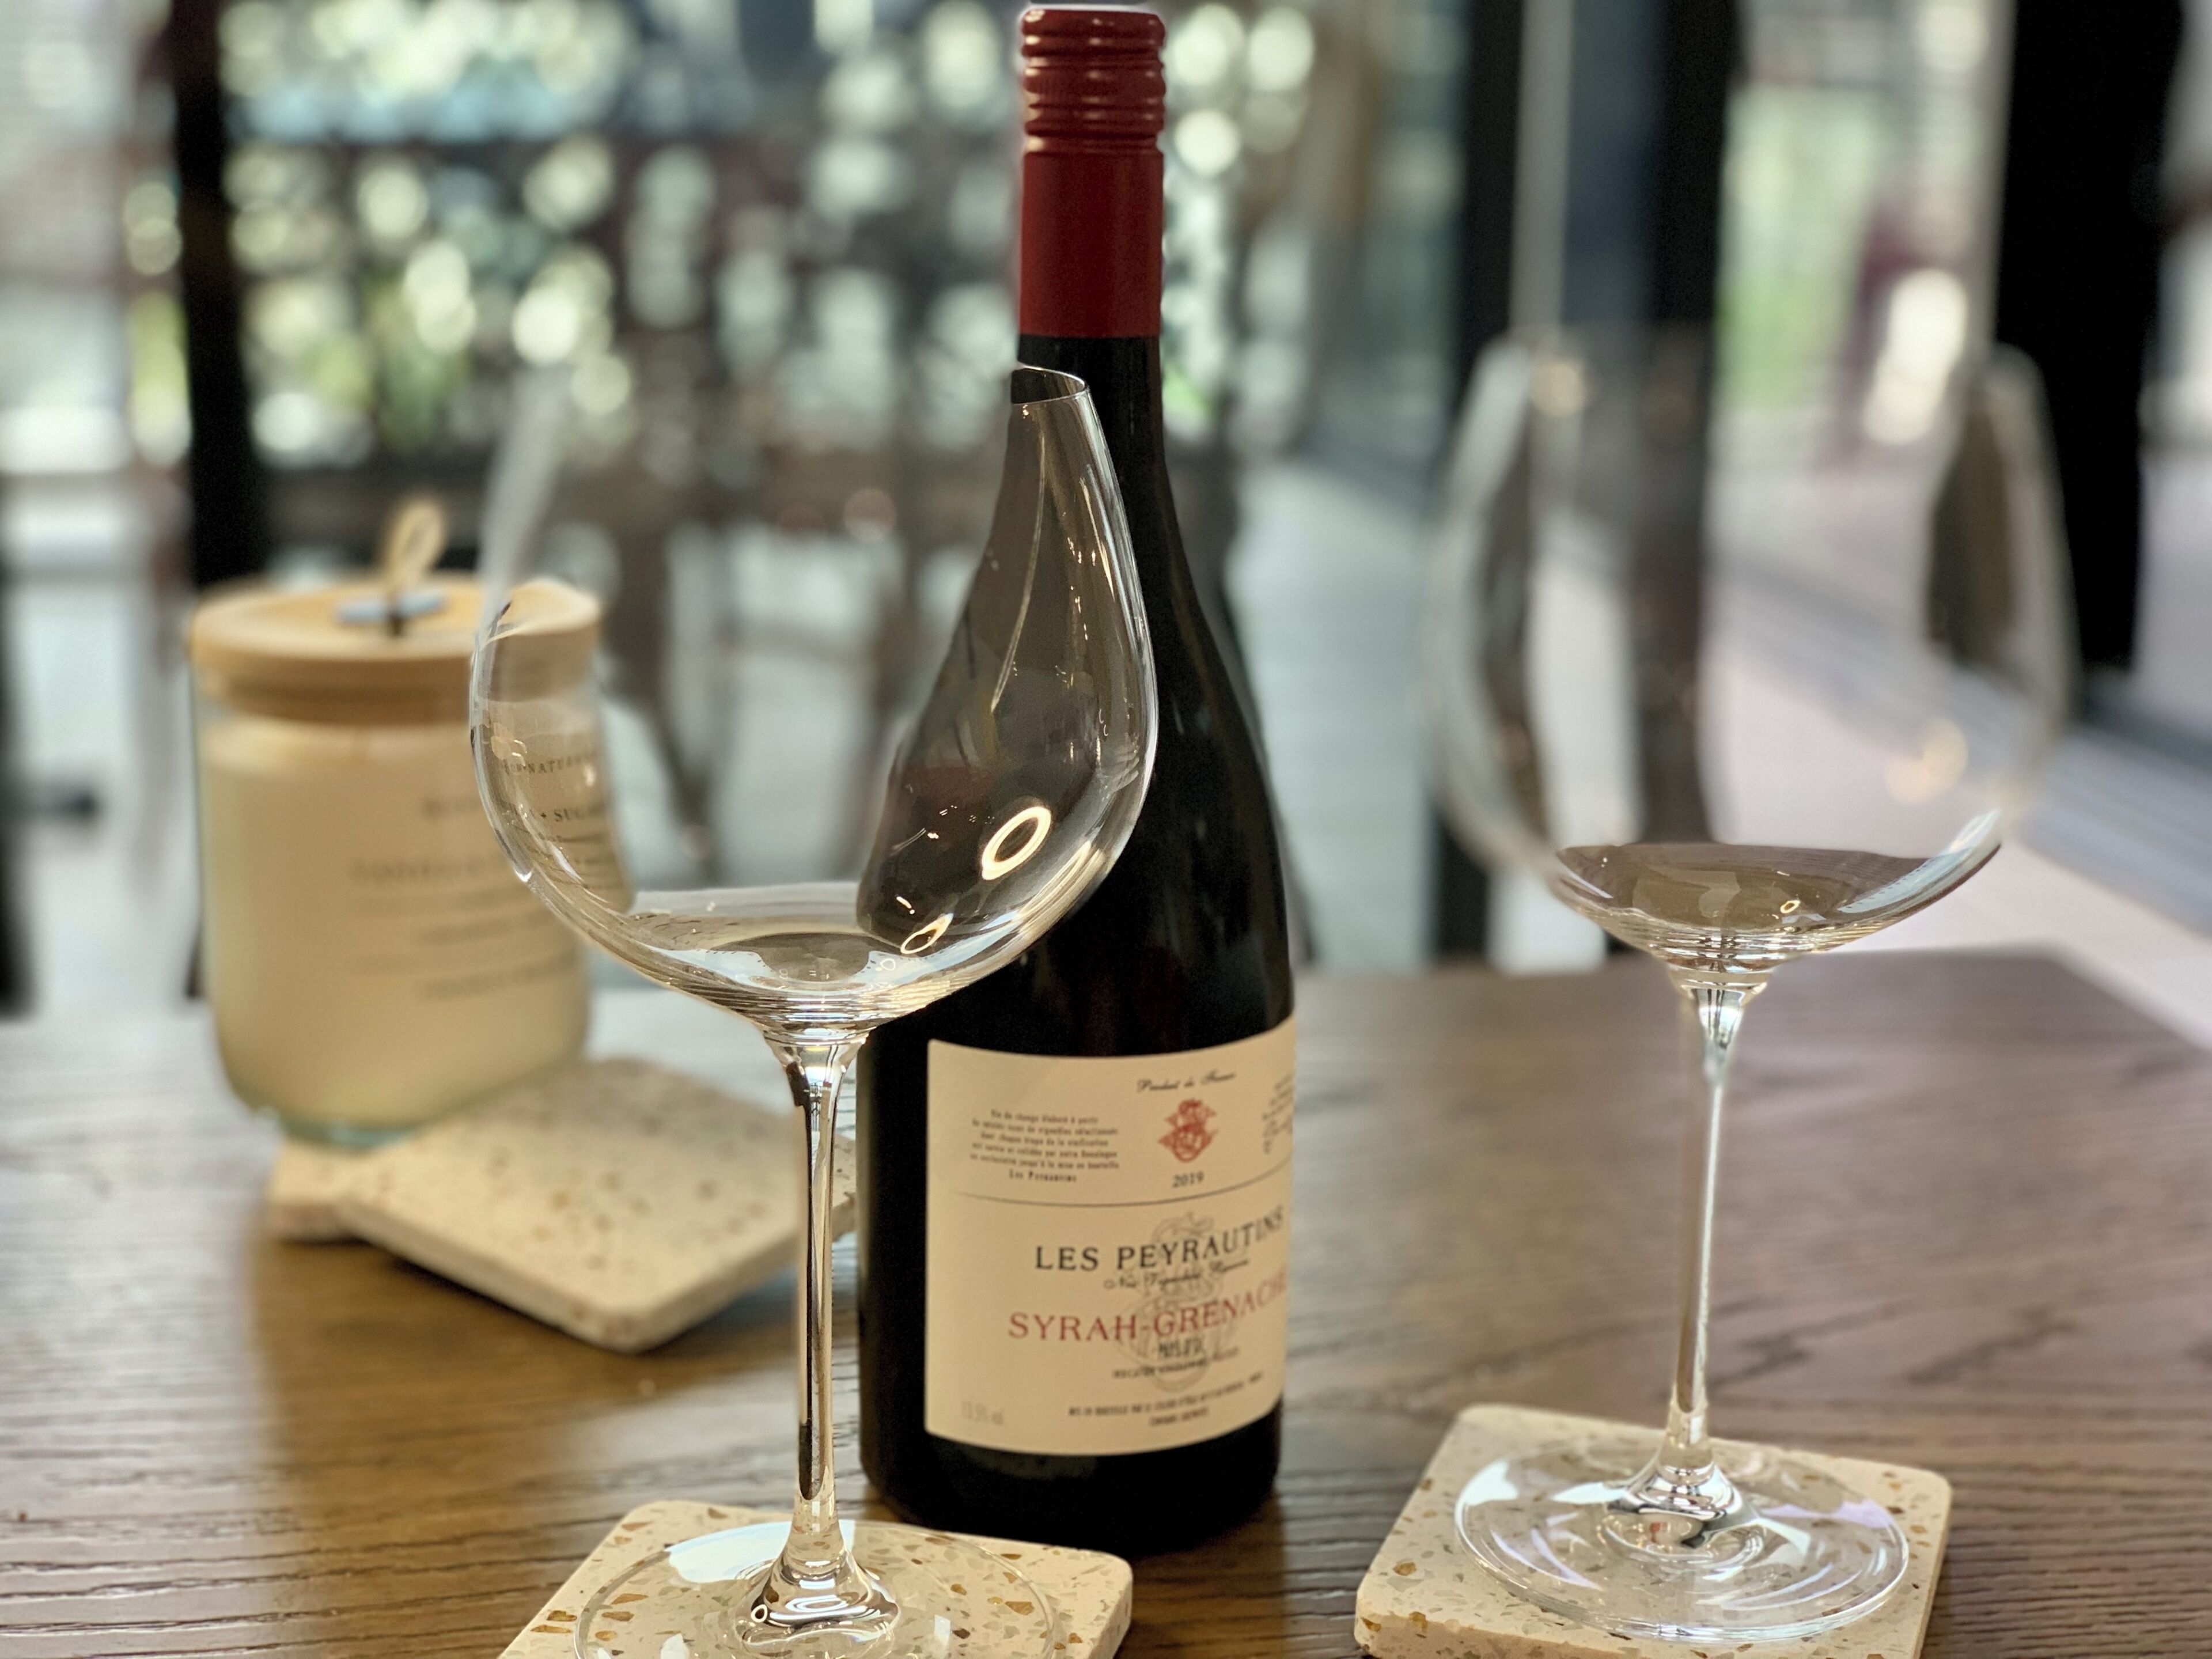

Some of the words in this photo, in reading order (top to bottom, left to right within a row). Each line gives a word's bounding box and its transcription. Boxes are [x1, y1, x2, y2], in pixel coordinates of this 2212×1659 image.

[1173, 1171, 1205, 1188] 2019
[1035, 1245, 1099, 1271] LES
[1116, 1205, 1284, 1270] PEYRAUTINS
